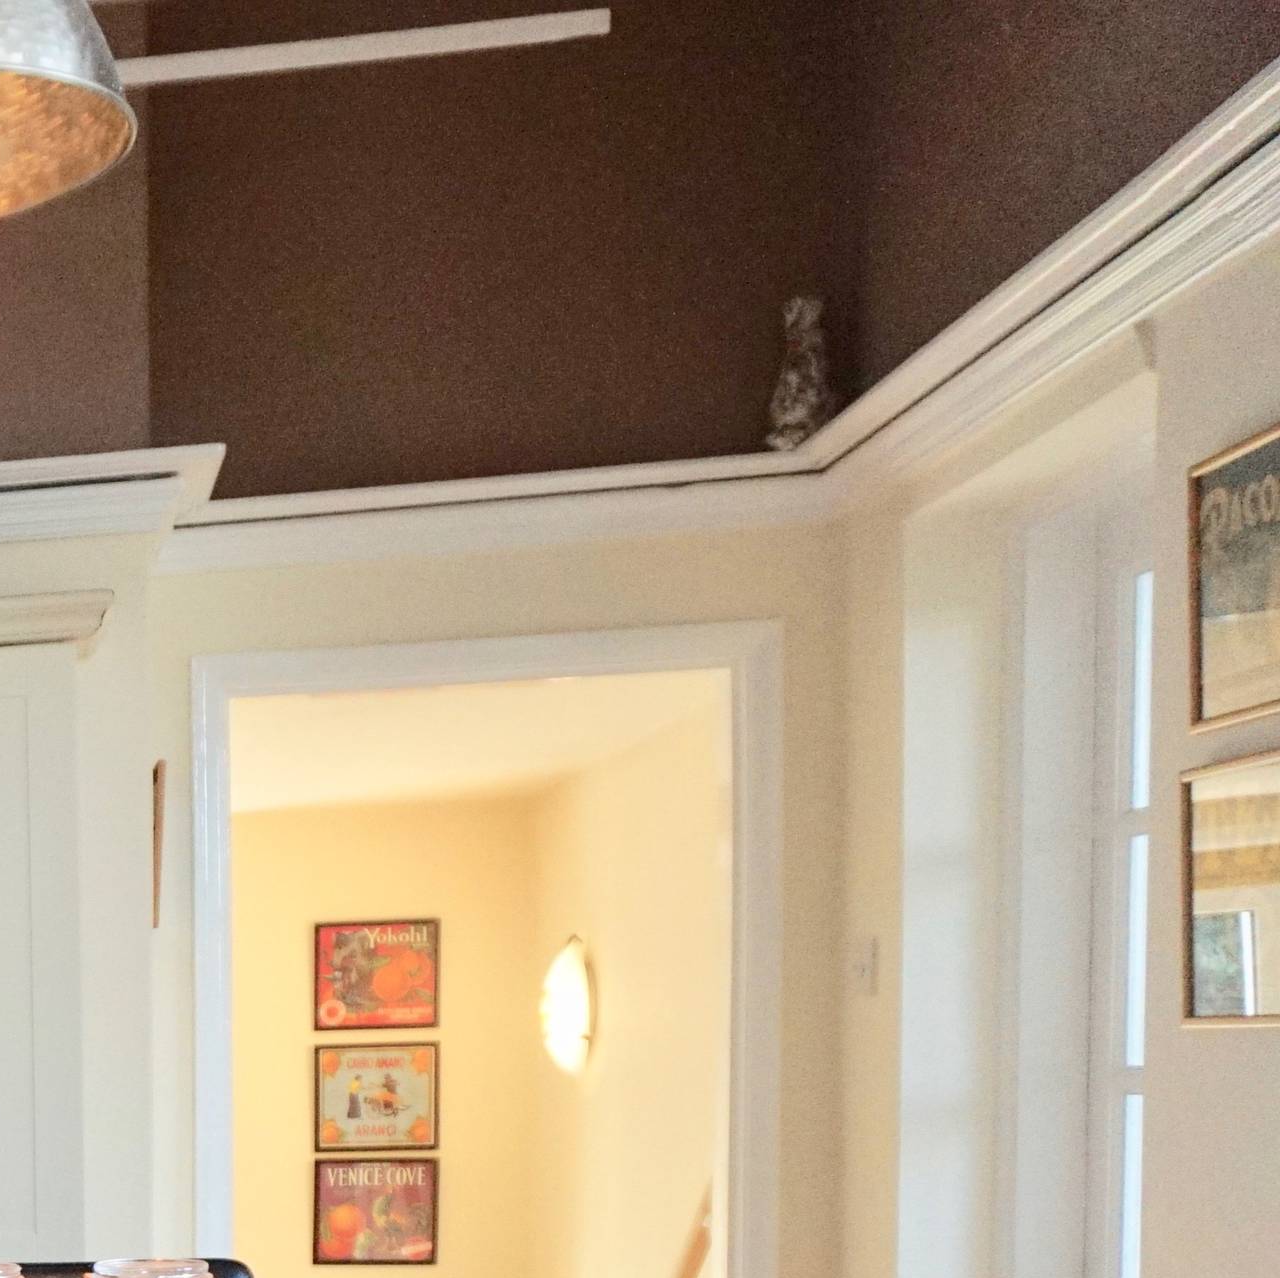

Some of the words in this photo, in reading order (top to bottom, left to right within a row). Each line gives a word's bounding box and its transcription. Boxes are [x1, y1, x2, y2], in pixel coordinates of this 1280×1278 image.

[364, 926, 428, 949] Yokohl
[328, 1166, 383, 1187] VENICE
[387, 1166, 427, 1186] COVE
